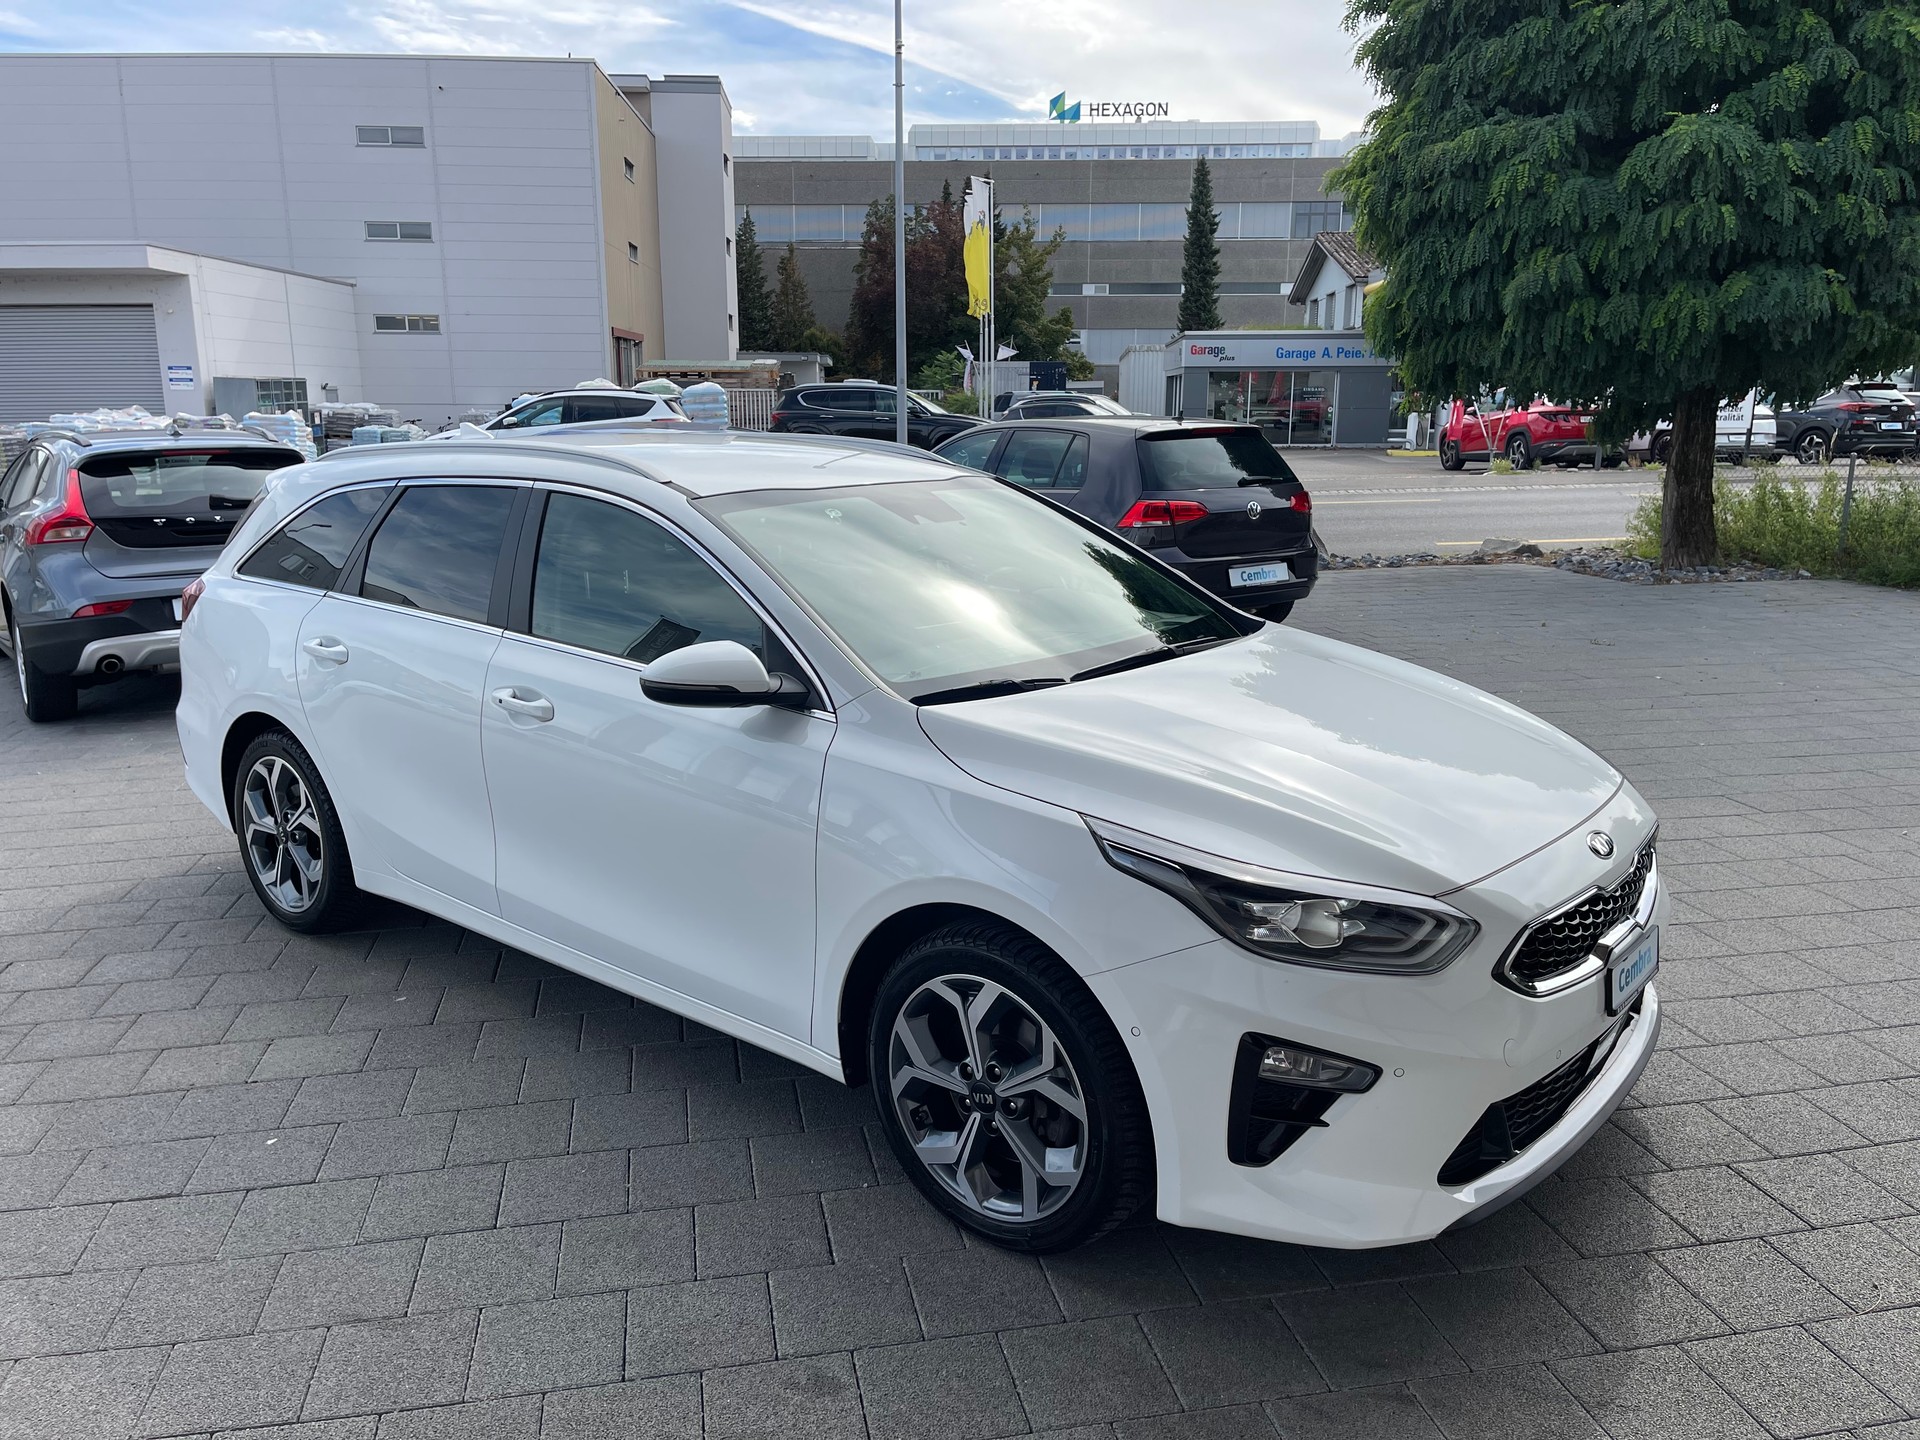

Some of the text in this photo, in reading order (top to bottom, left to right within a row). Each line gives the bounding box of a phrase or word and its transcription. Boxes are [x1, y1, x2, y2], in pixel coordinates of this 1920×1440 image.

[1089, 102, 1169, 117] HEXAGON
[1190, 344, 1226, 358] Garage
[1276, 347, 1316, 361] Garage
[1321, 347, 1333, 359] A.
[1240, 567, 1278, 582] Cembra
[1618, 946, 1654, 993] Cembra
[972, 1092, 994, 1105] KIA
